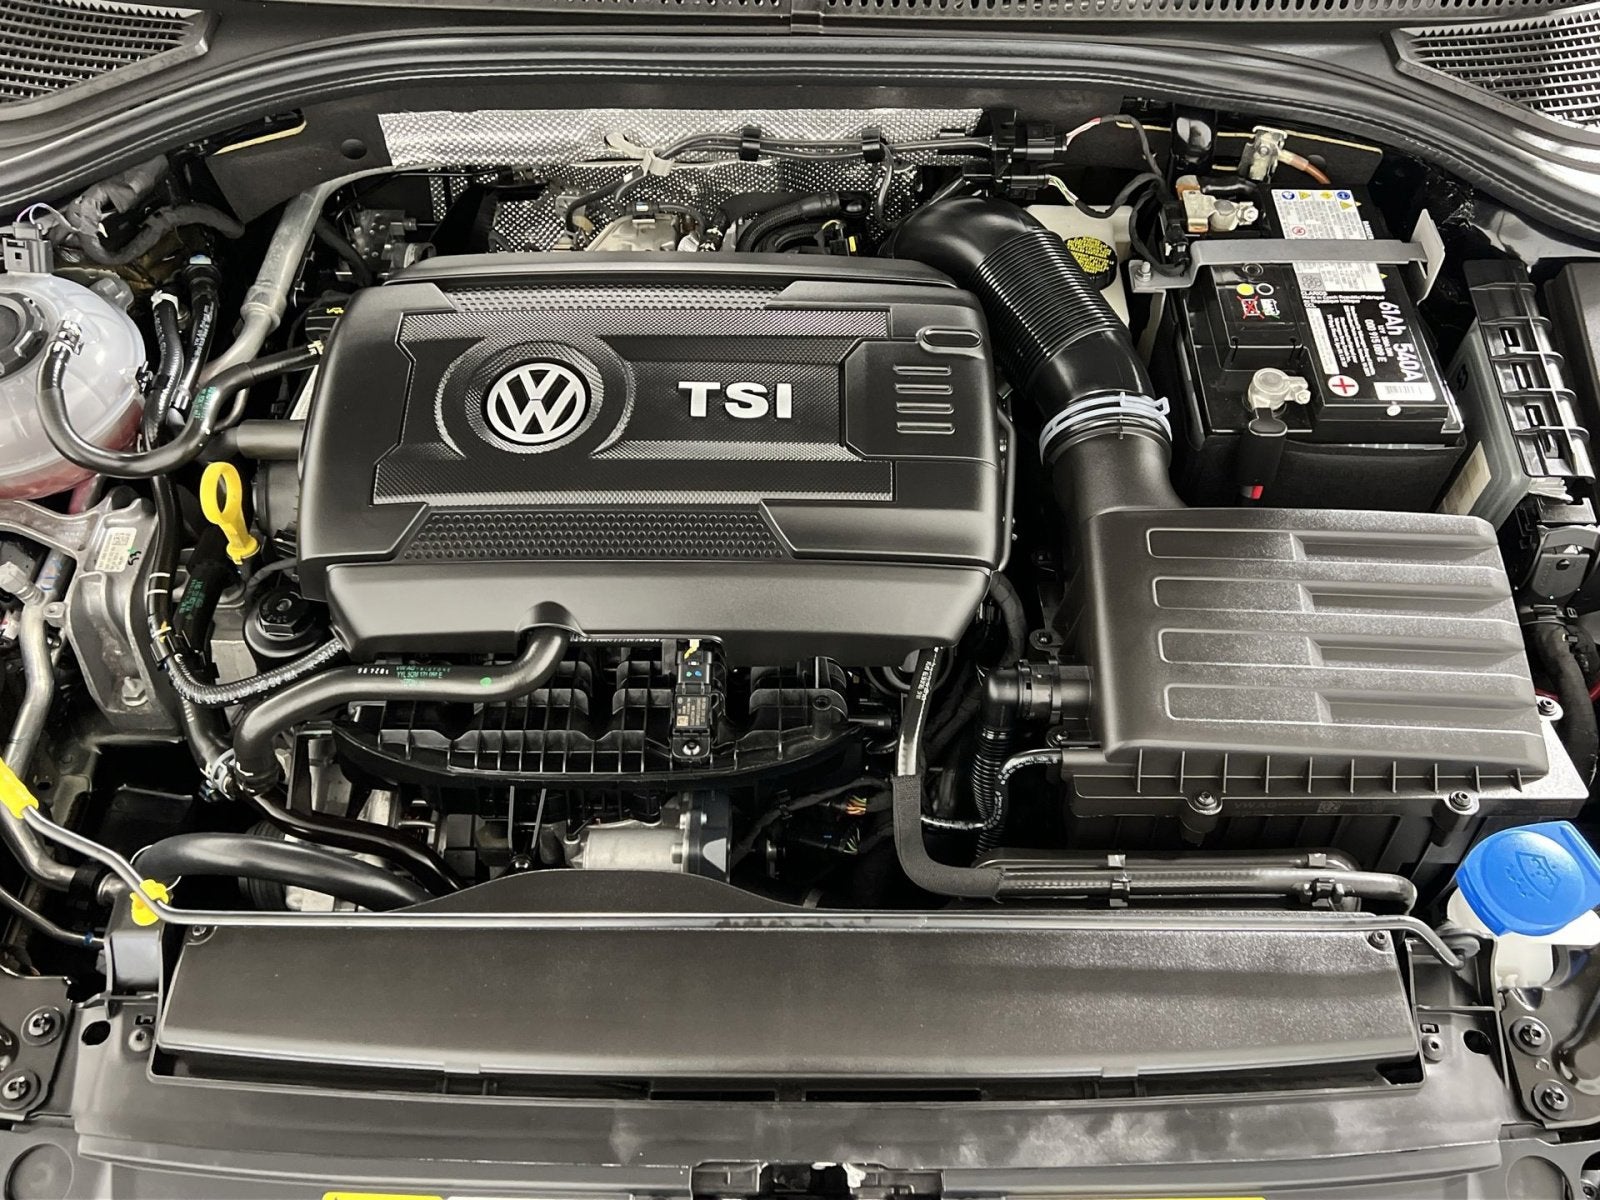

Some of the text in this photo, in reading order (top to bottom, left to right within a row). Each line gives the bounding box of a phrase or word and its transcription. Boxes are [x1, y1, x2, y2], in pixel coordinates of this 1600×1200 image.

[1378, 301, 1424, 382] 61Ah 540A
[677, 380, 793, 419] TSI
